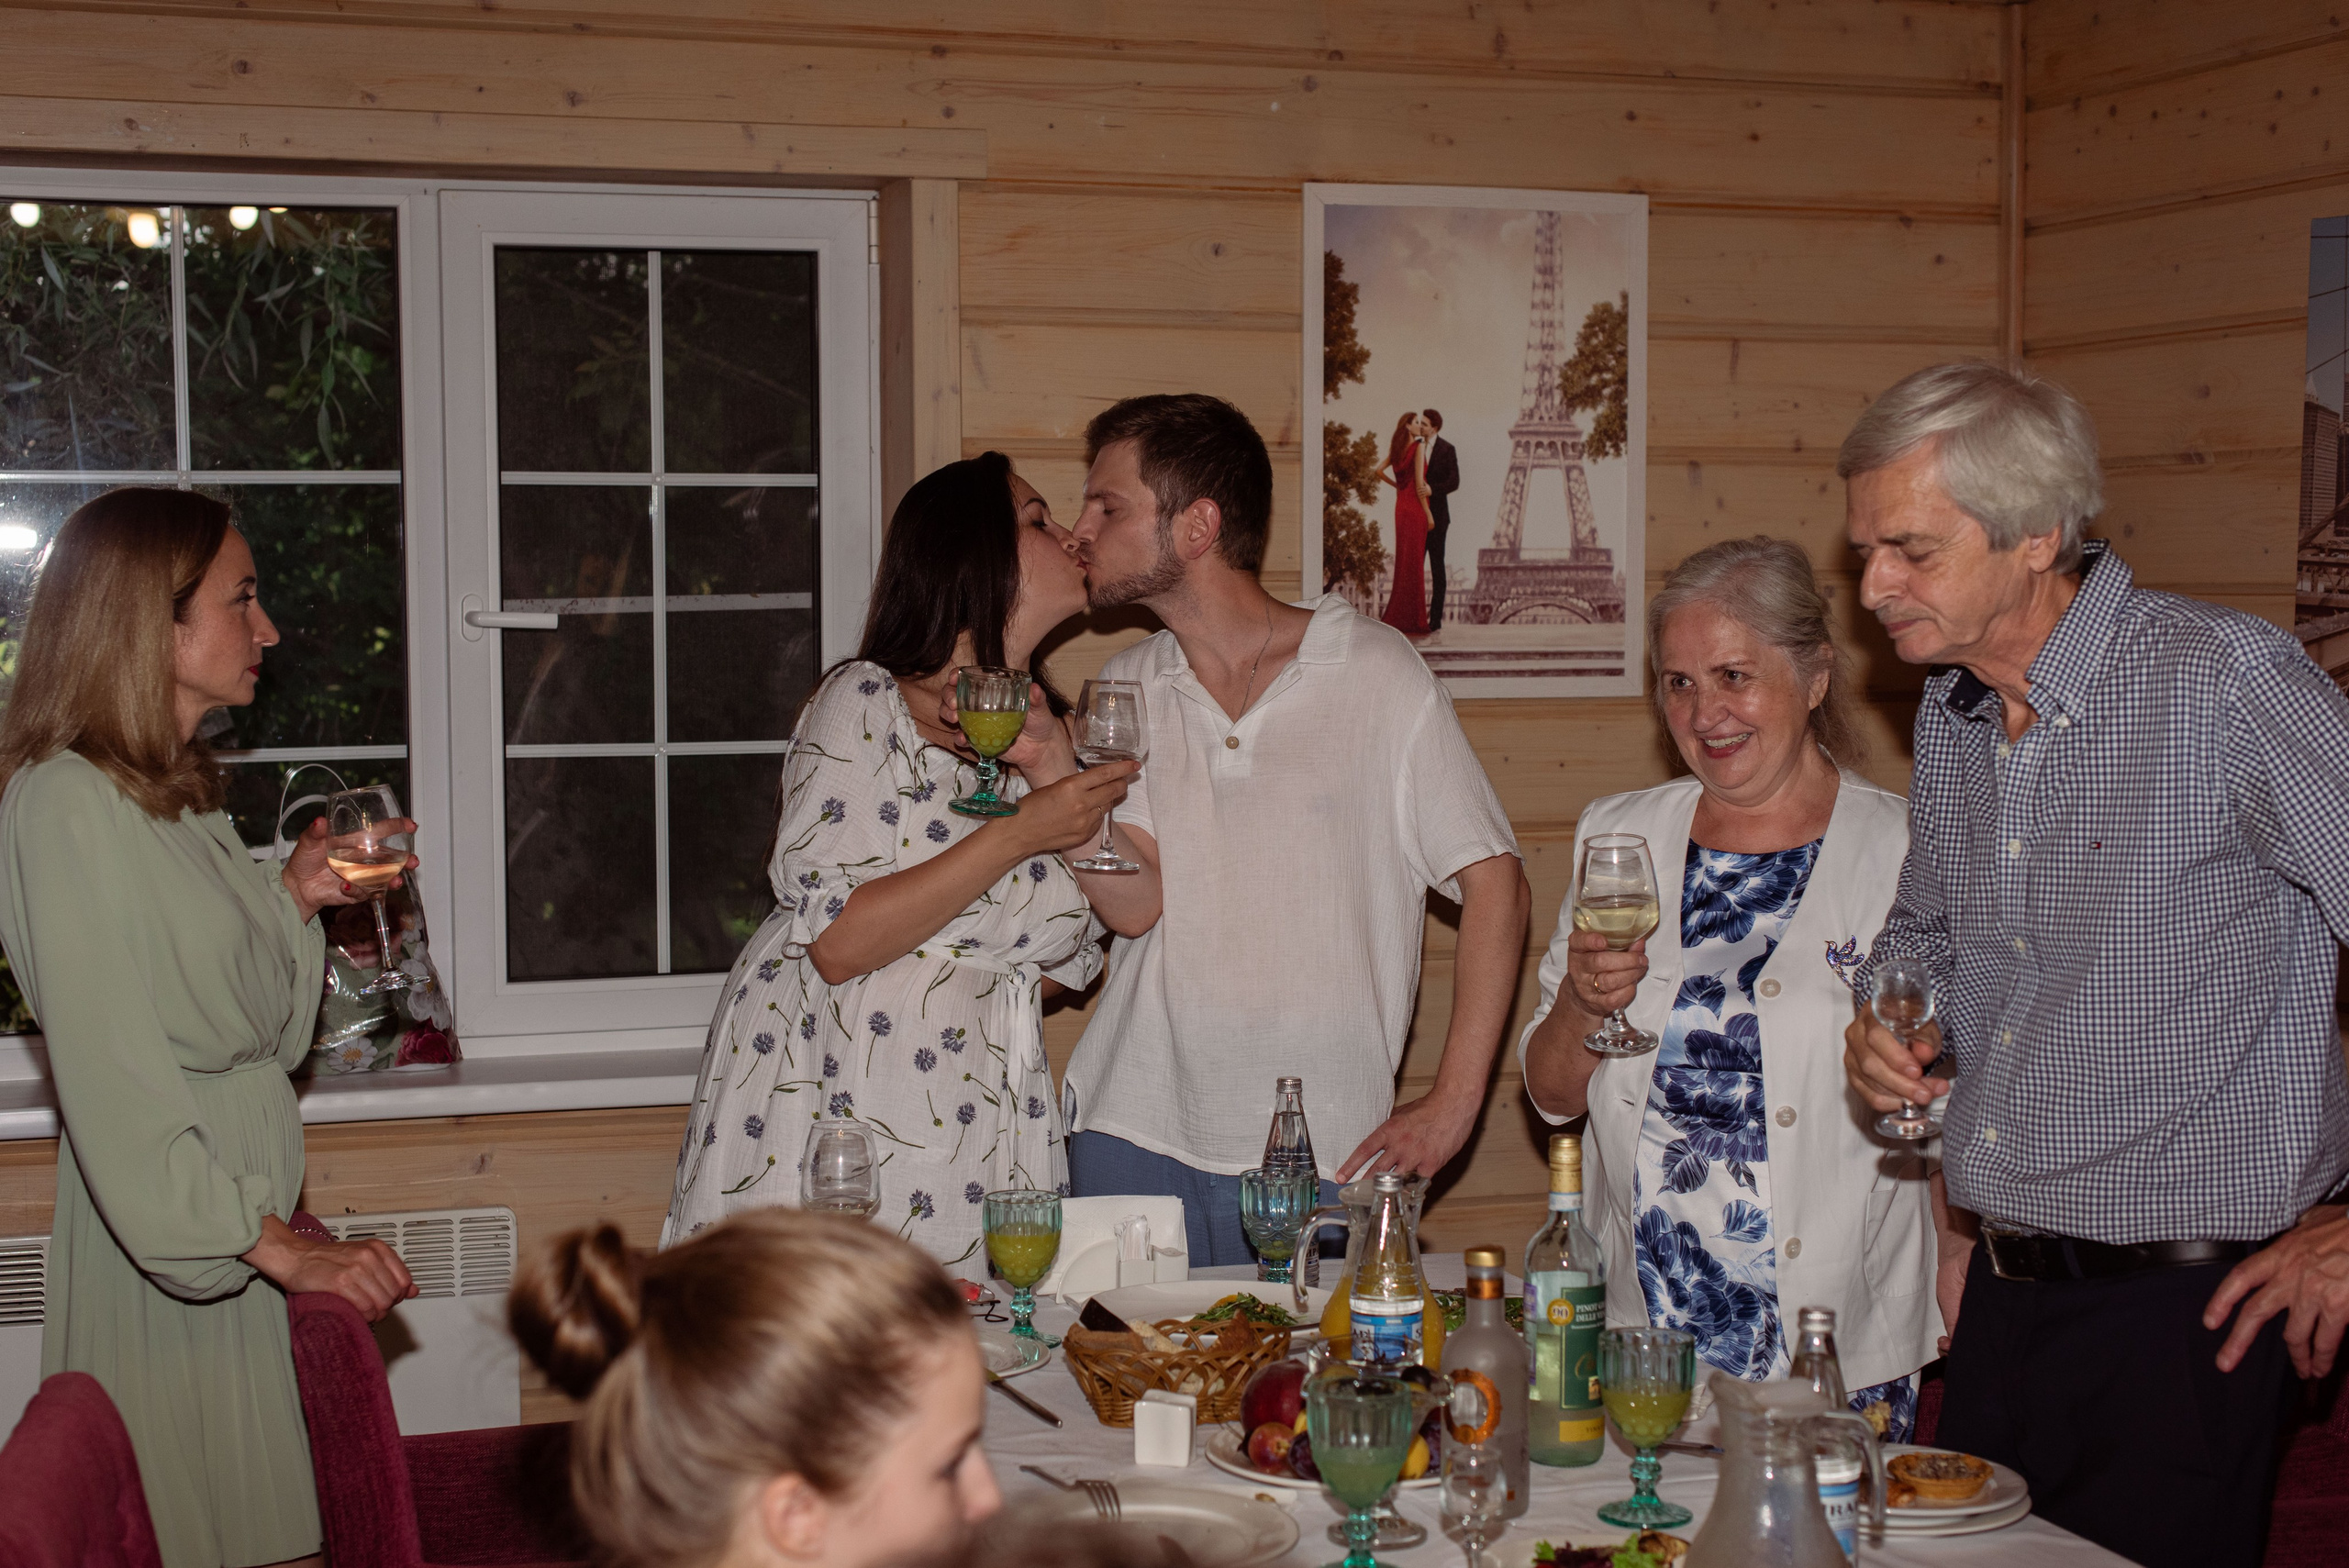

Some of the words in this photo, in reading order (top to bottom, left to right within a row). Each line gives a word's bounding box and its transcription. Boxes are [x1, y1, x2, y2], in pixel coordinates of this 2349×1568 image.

[1552, 1306, 1569, 1319] 90
[1575, 1303, 1598, 1313] PINOT
[1575, 1313, 1597, 1322] DELLE
